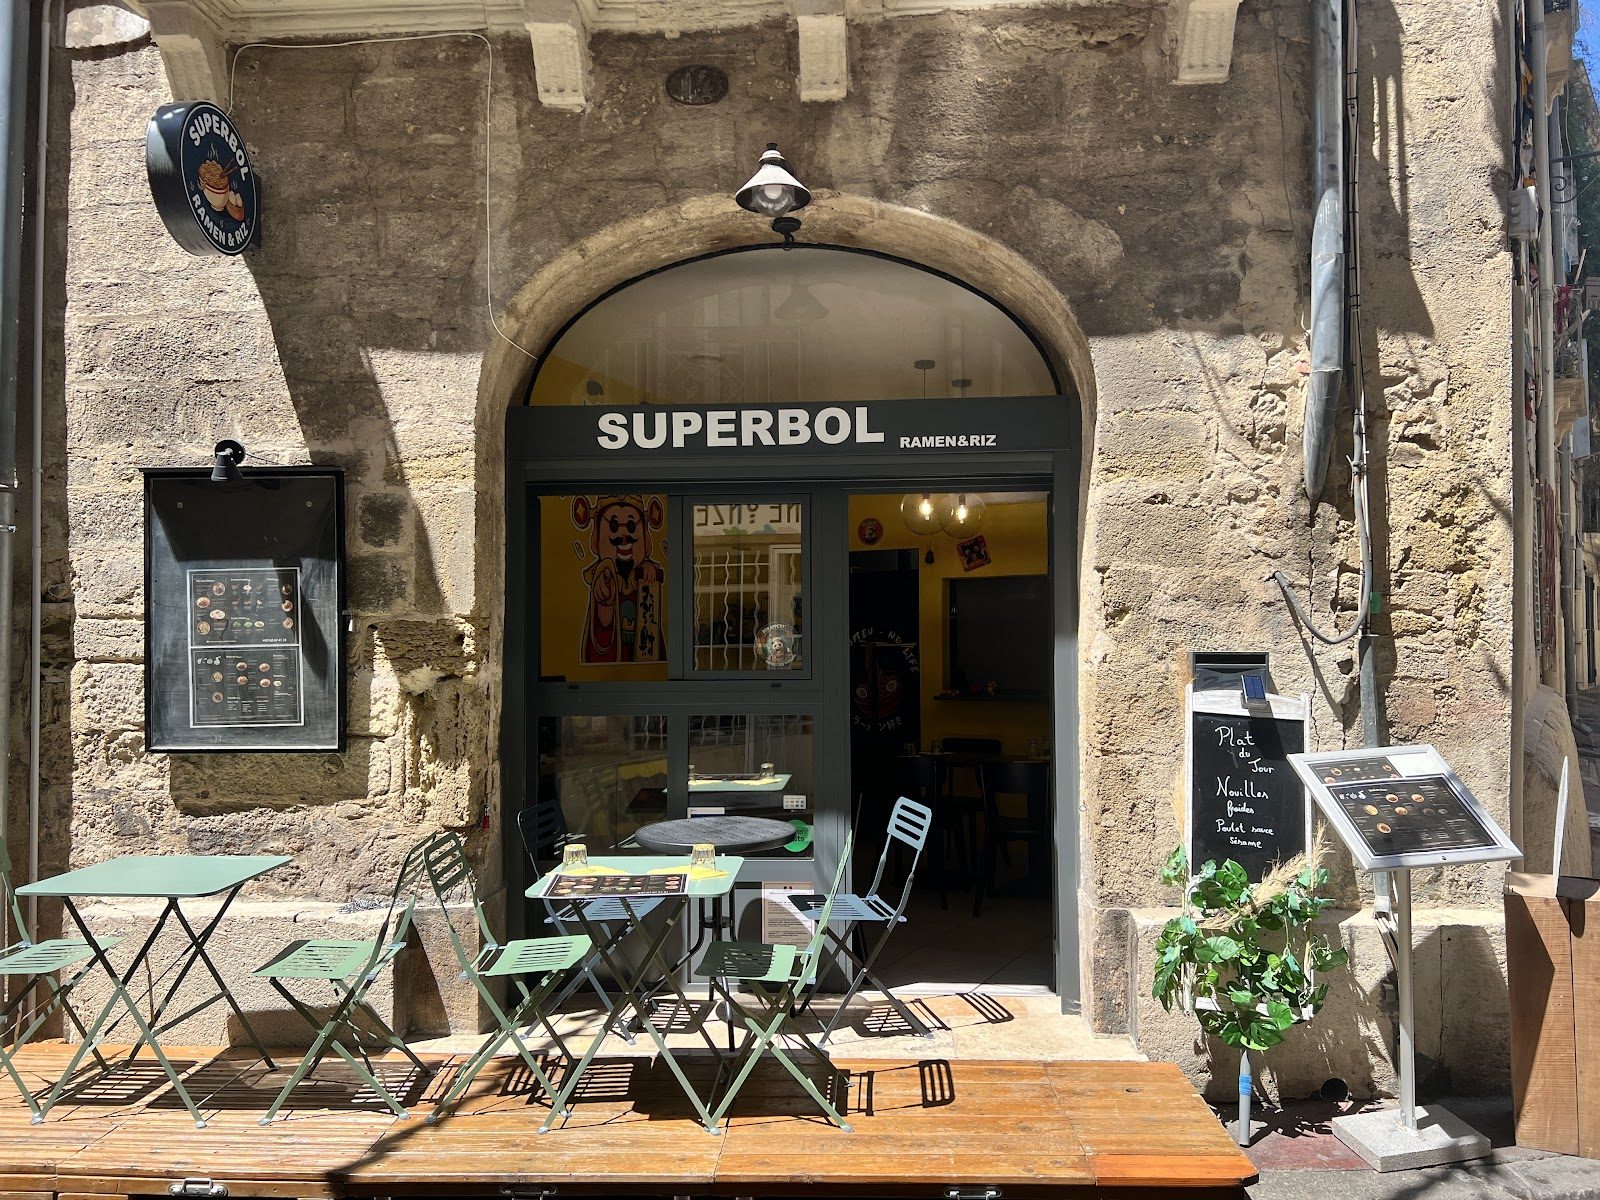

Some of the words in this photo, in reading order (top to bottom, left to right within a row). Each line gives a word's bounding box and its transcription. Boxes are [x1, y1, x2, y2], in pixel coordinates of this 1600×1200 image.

[189, 113, 250, 181] SUPERBOL
[192, 193, 226, 247] RAMEN
[227, 232, 235, 247] &
[235, 221, 249, 245] RIZ
[597, 407, 885, 450] SUPERBOL
[900, 434, 997, 449] RAMEN&RIZ
[1215, 726, 1255, 746] Plat
[1239, 747, 1251, 758] du
[1248, 758, 1275, 774] Jour
[1216, 776, 1269, 799] Nouilles
[1215, 818, 1246, 833] Poulet
[1251, 826, 1275, 836] sauce
